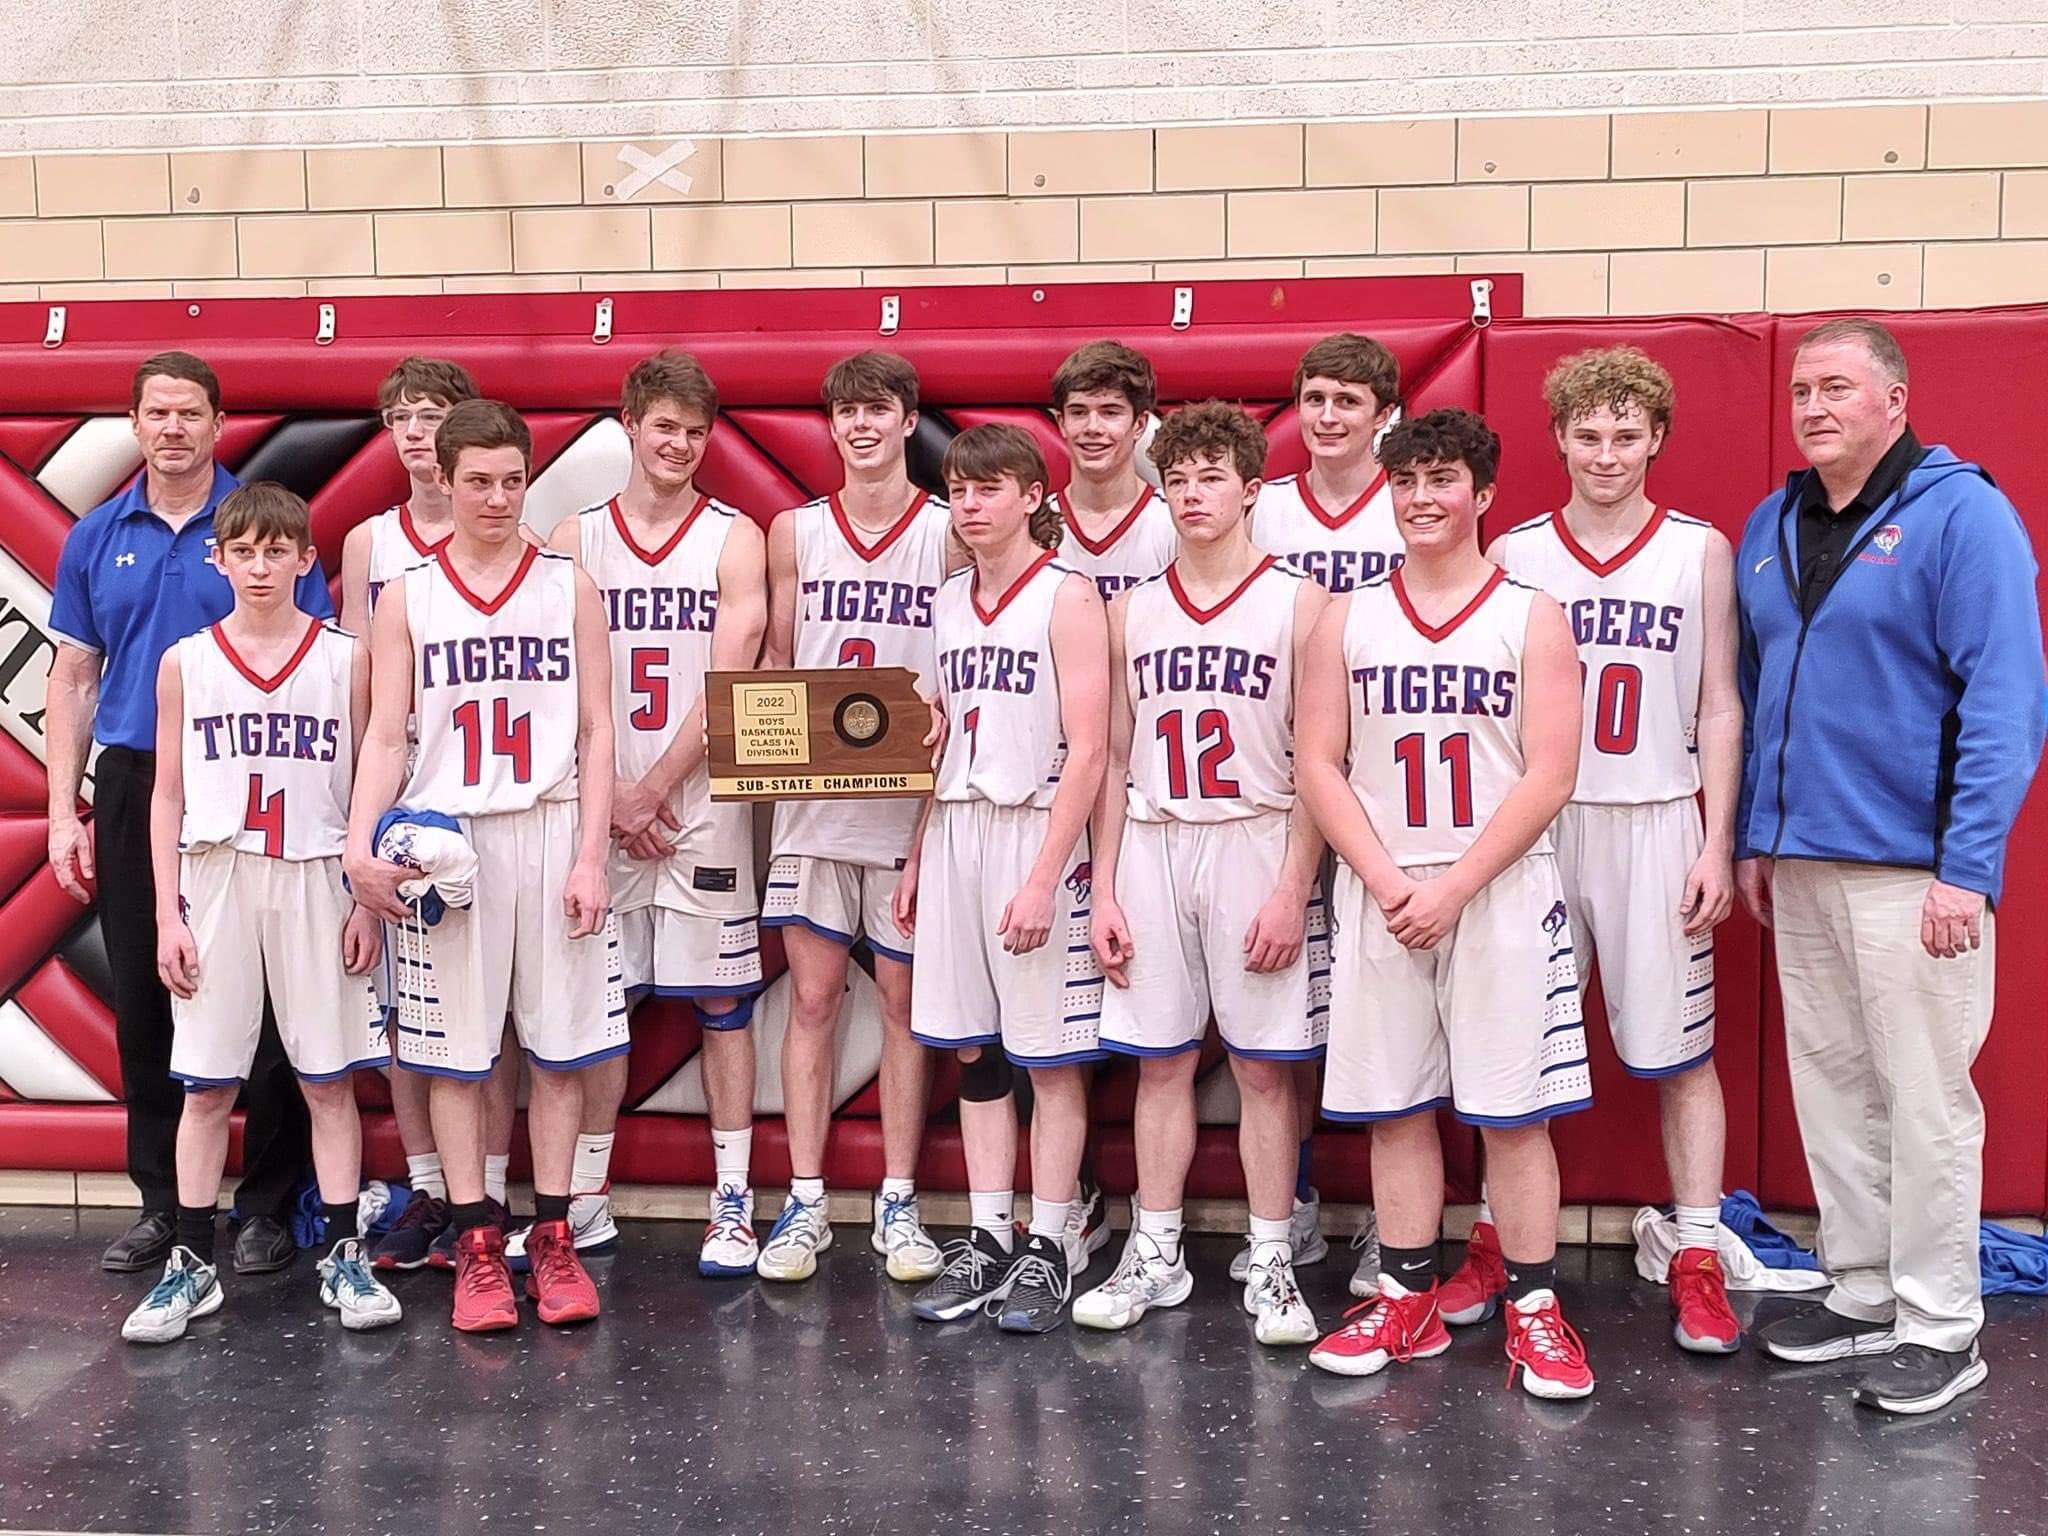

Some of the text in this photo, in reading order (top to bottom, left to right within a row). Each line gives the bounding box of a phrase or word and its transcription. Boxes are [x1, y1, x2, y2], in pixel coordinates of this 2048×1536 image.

[600, 587, 718, 633] IGERS
[1560, 598, 1685, 653] GERS
[423, 636, 571, 690] TIGERS
[630, 648, 669, 731] 5
[1133, 645, 1278, 701] TIGERS
[757, 697, 785, 708] 2022
[1352, 665, 1516, 719] TIGERS
[1579, 661, 1643, 755] 0
[193, 713, 340, 763] TIGERS
[453, 697, 531, 787] 14
[741, 727, 804, 737] BASKETBALL
[749, 739, 782, 747] CLASS
[758, 717, 785, 726] BOYS
[746, 748, 789, 757] DIVISION
[1156, 708, 1242, 799] 12
[737, 776, 908, 792] SUB-STATE CHAMPIONS
[1394, 732, 1474, 828] 11
[243, 773, 285, 859] 4
